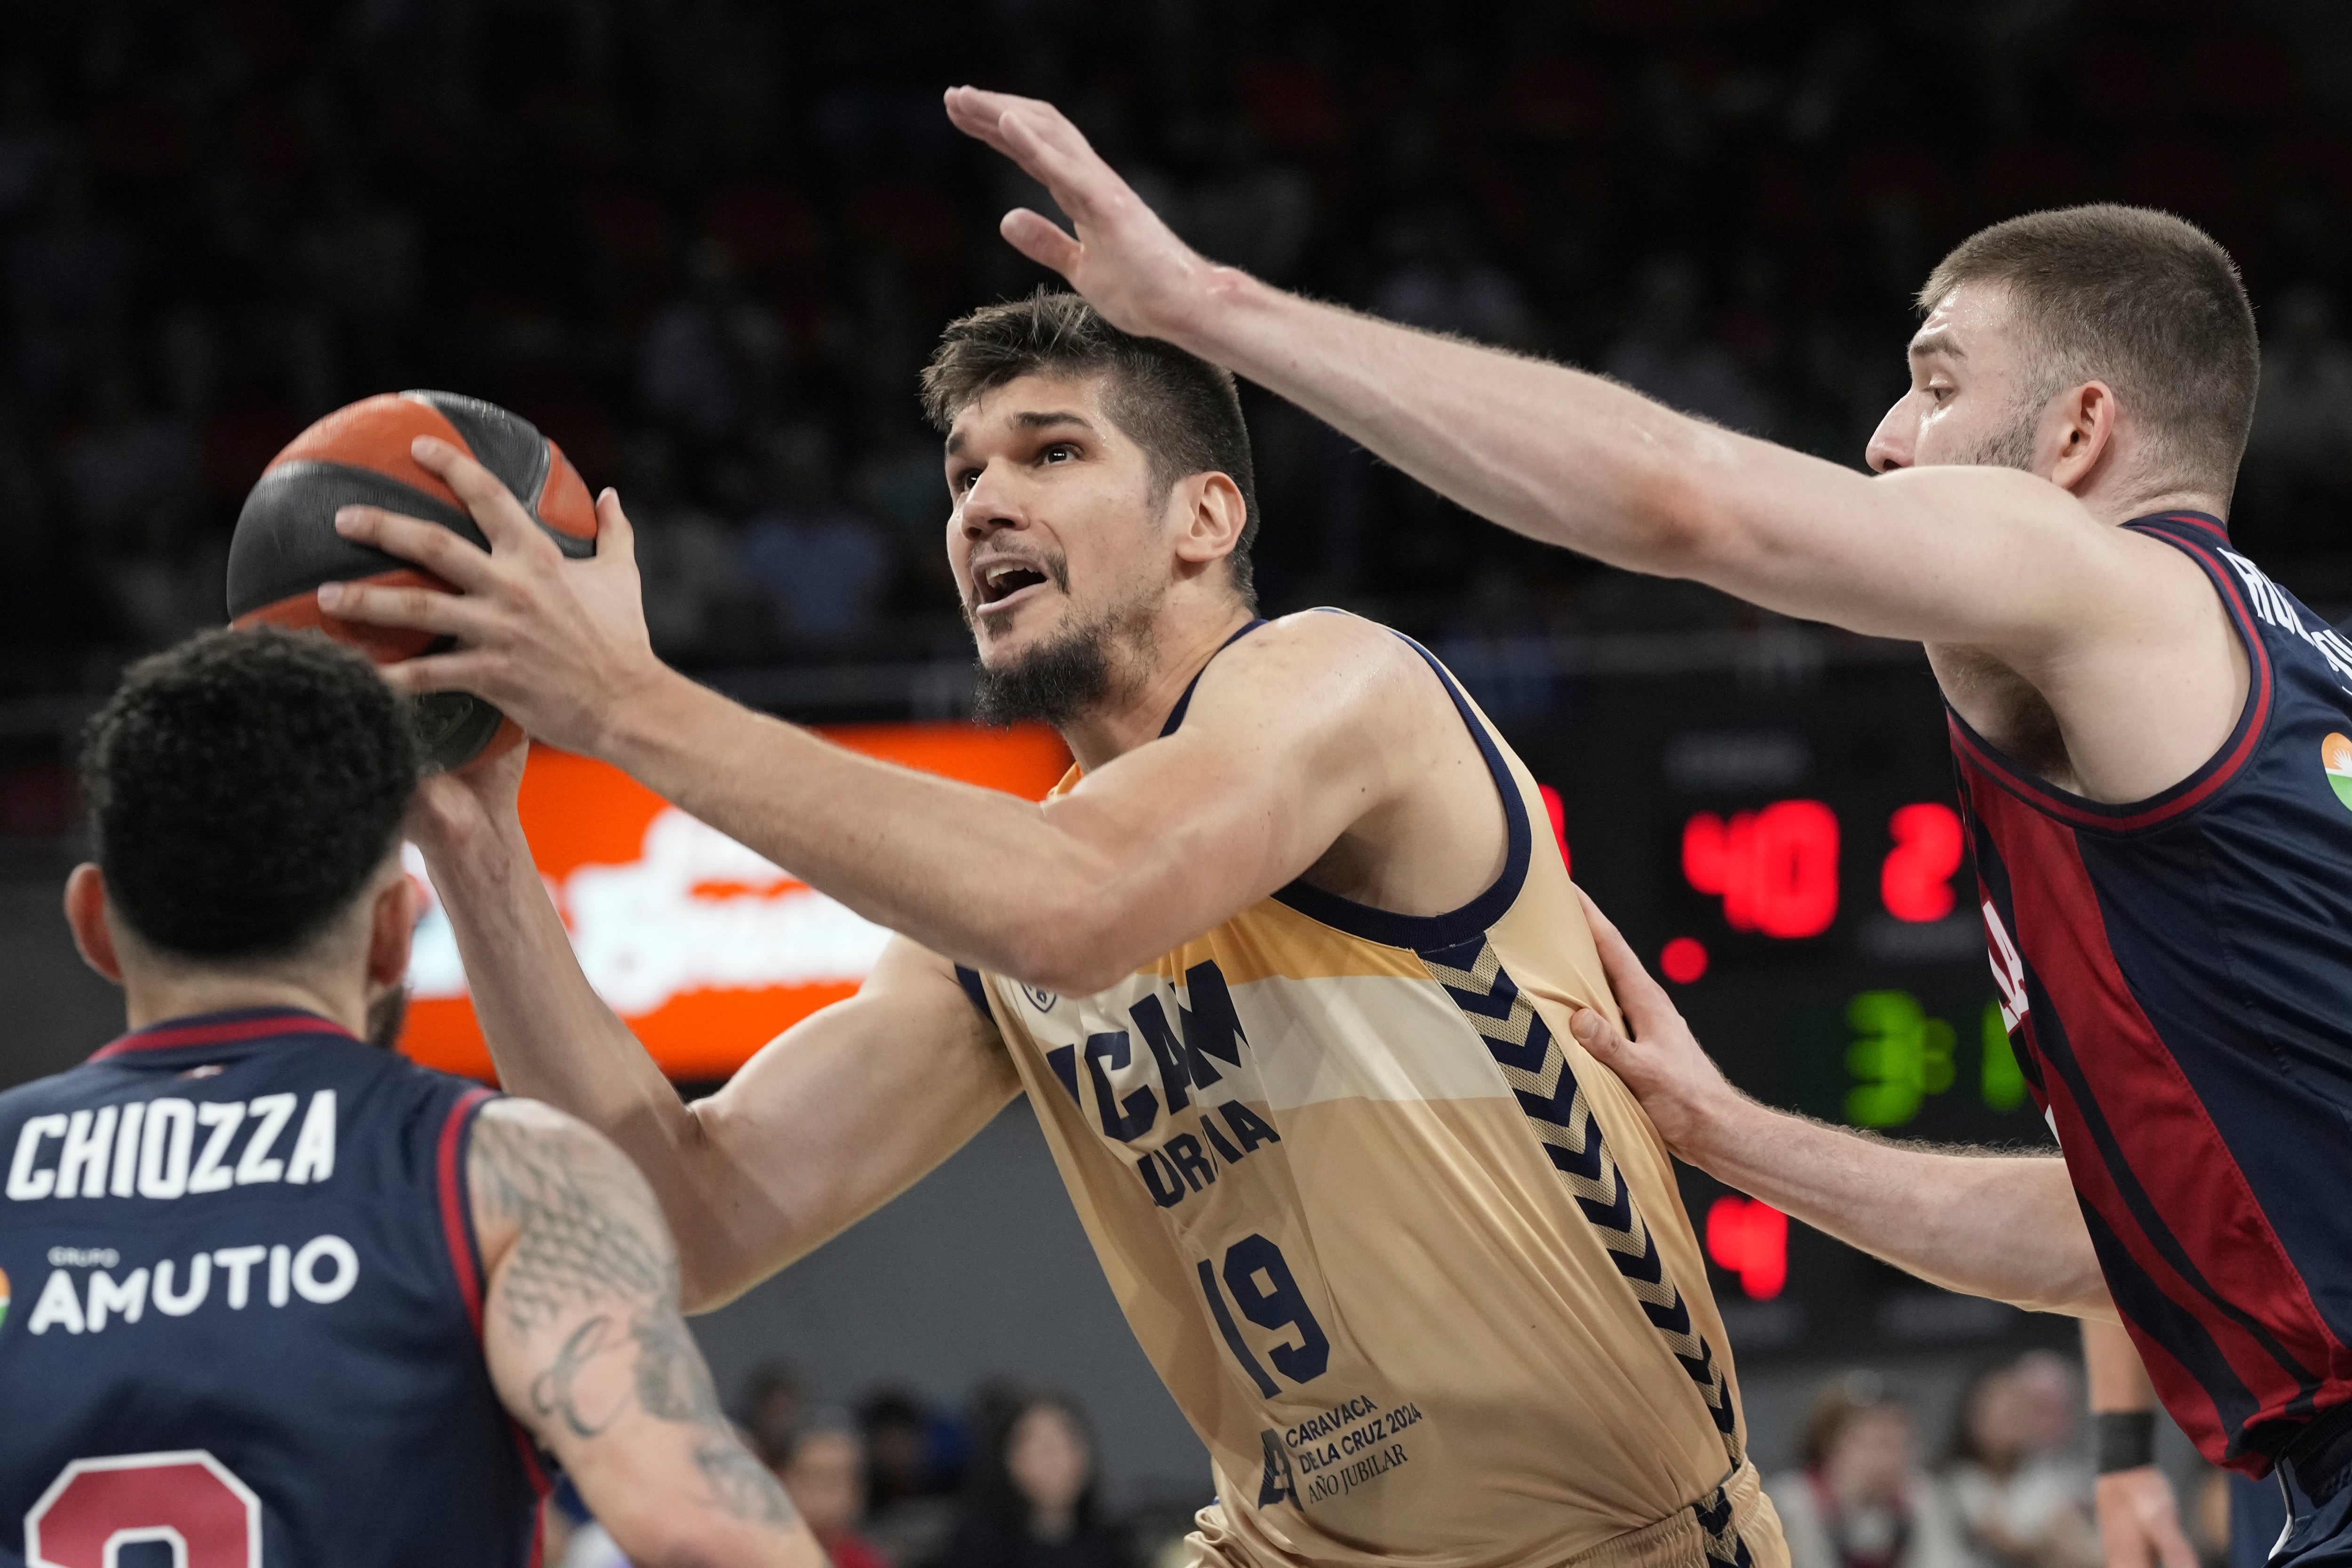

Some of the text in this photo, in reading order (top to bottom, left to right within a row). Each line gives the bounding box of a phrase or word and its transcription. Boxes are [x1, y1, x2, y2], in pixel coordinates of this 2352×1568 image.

[6, 1089, 337, 1201] CHIOZZA
[1136, 1099, 1281, 1209] URIA
[27, 1234, 359, 1335] AMUTIO
[47, 1246, 120, 1269] GRUPO
[1197, 1233, 1330, 1400] 19
[1286, 1394, 1378, 1448] CARAVACA
[1298, 1402, 1423, 1474] DE LA CRUZ 2024
[1308, 1443, 1408, 1504] AÑO JUBILAR
